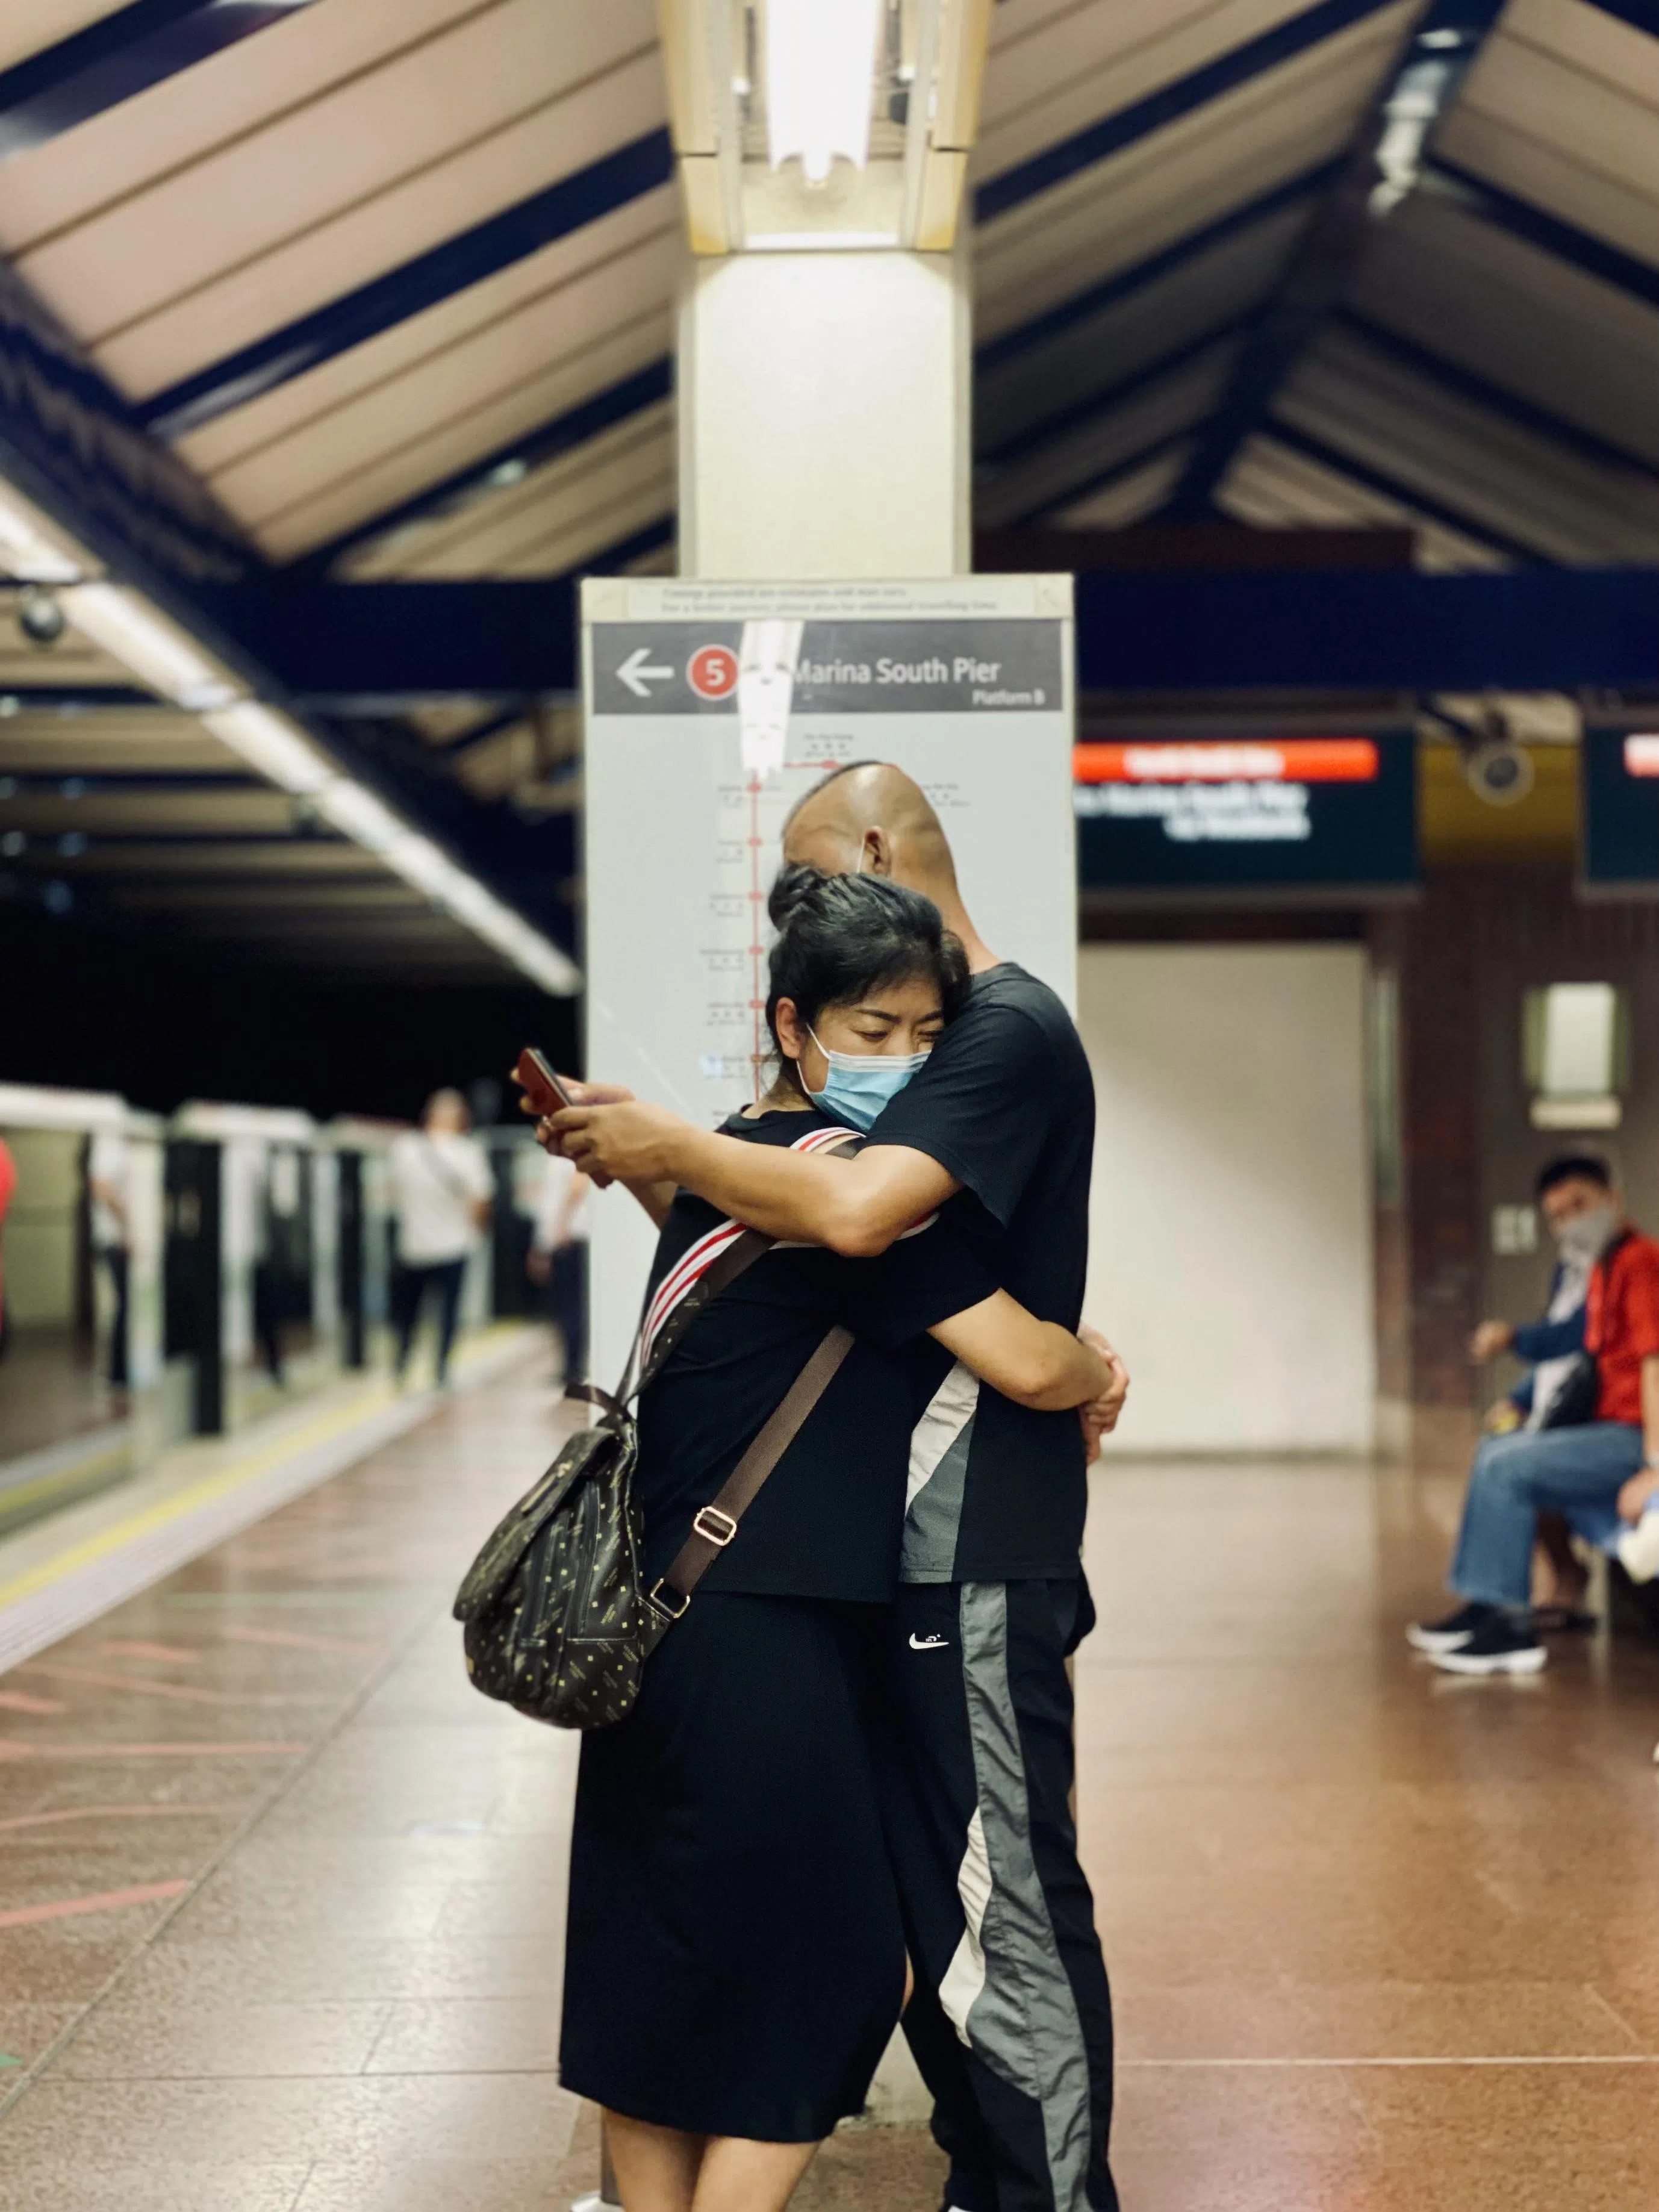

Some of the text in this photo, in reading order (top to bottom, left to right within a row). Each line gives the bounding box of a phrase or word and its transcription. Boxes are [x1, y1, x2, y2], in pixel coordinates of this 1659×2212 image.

[705, 658, 726, 687] 5
[876, 657, 949, 684] South
[953, 656, 1002, 684] Pier
[971, 688, 1032, 706] Platform
